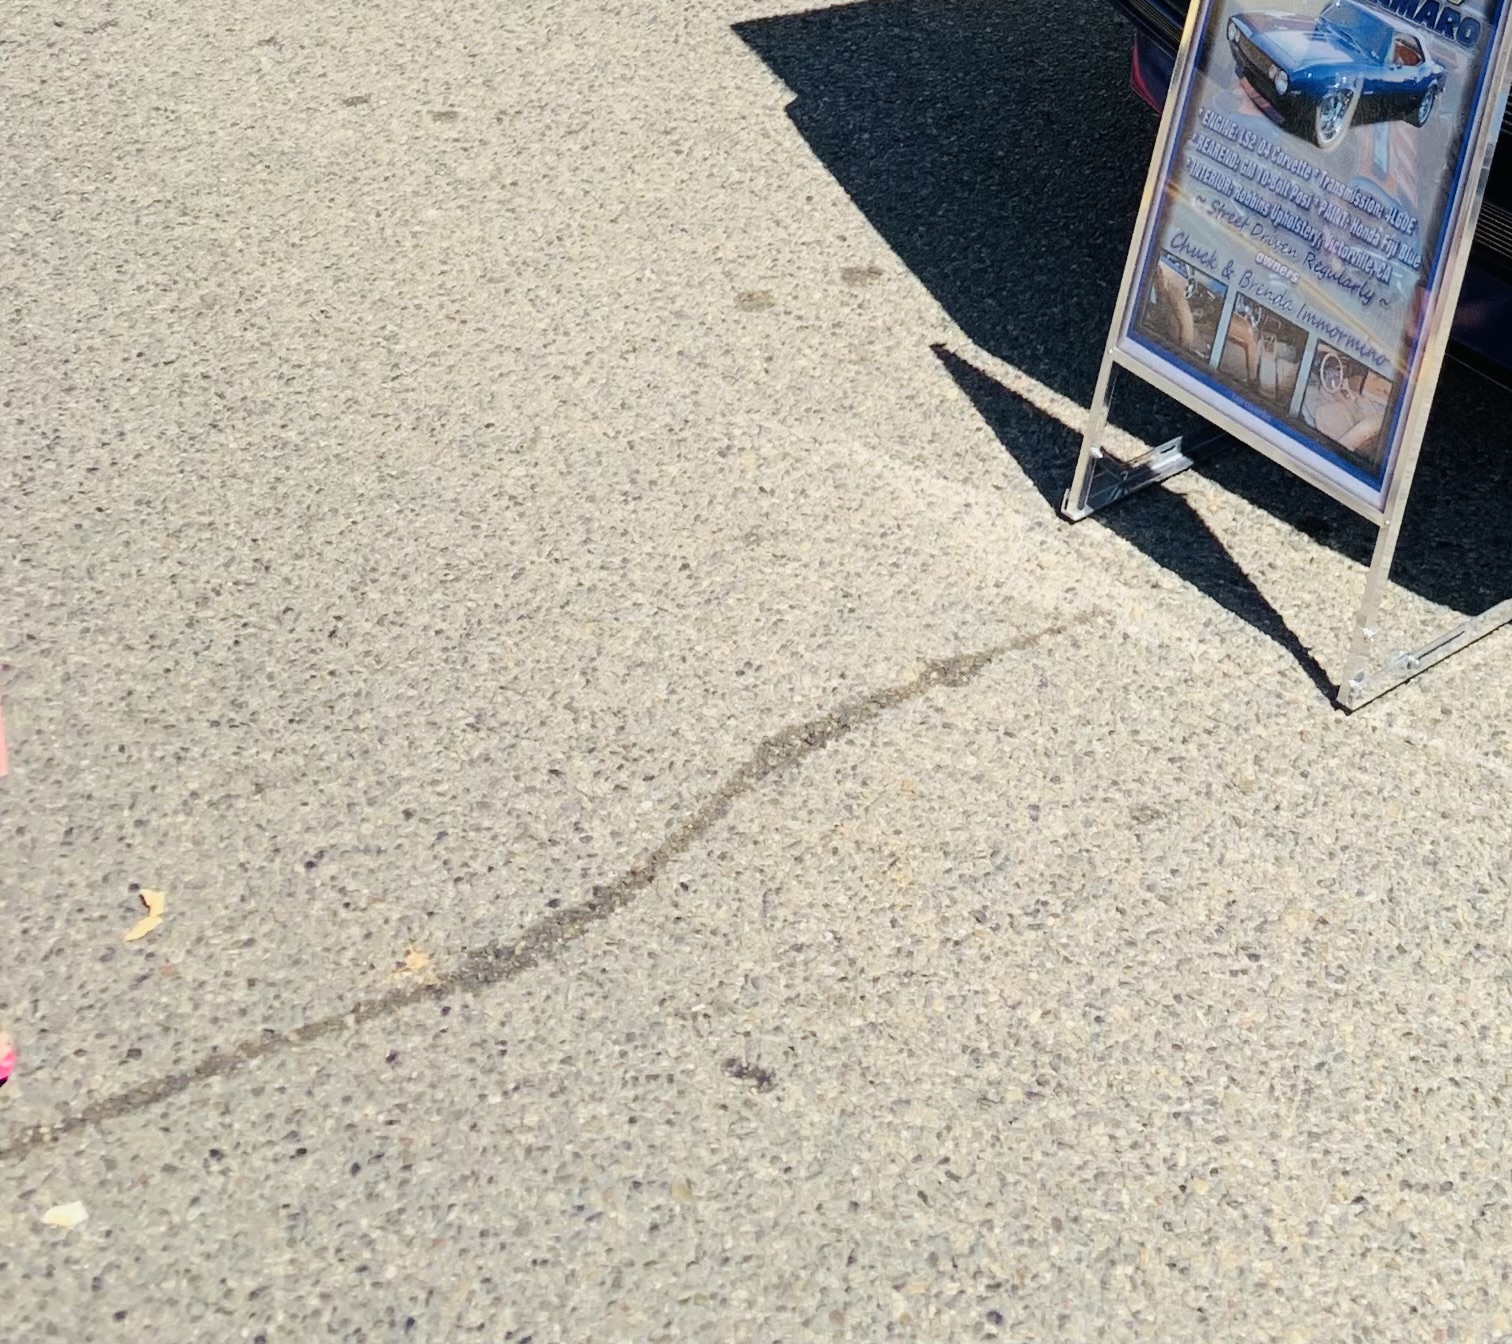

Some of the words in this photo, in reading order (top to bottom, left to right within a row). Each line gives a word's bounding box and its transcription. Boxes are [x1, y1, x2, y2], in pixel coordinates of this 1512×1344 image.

[1237, 127, 1256, 150] LS2
[1270, 146, 1312, 180] Corvette
[1208, 197, 1249, 232] Street
[1250, 220, 1299, 260] Driven
[1301, 249, 1376, 308] Regularly
[1233, 183, 1270, 216] Robbins
[1375, 262, 1392, 285] CA
[1239, 157, 1255, 179] GM
[1289, 184, 1312, 210] Posi
[1349, 217, 1380, 248] Honda
[1379, 234, 1399, 262] Fiji
[1397, 243, 1422, 271] Blue
[1169, 227, 1219, 271] Chuck
[1220, 256, 1235, 280] &
[1238, 266, 1294, 313] Brenda
[1254, 249, 1300, 285] owners
